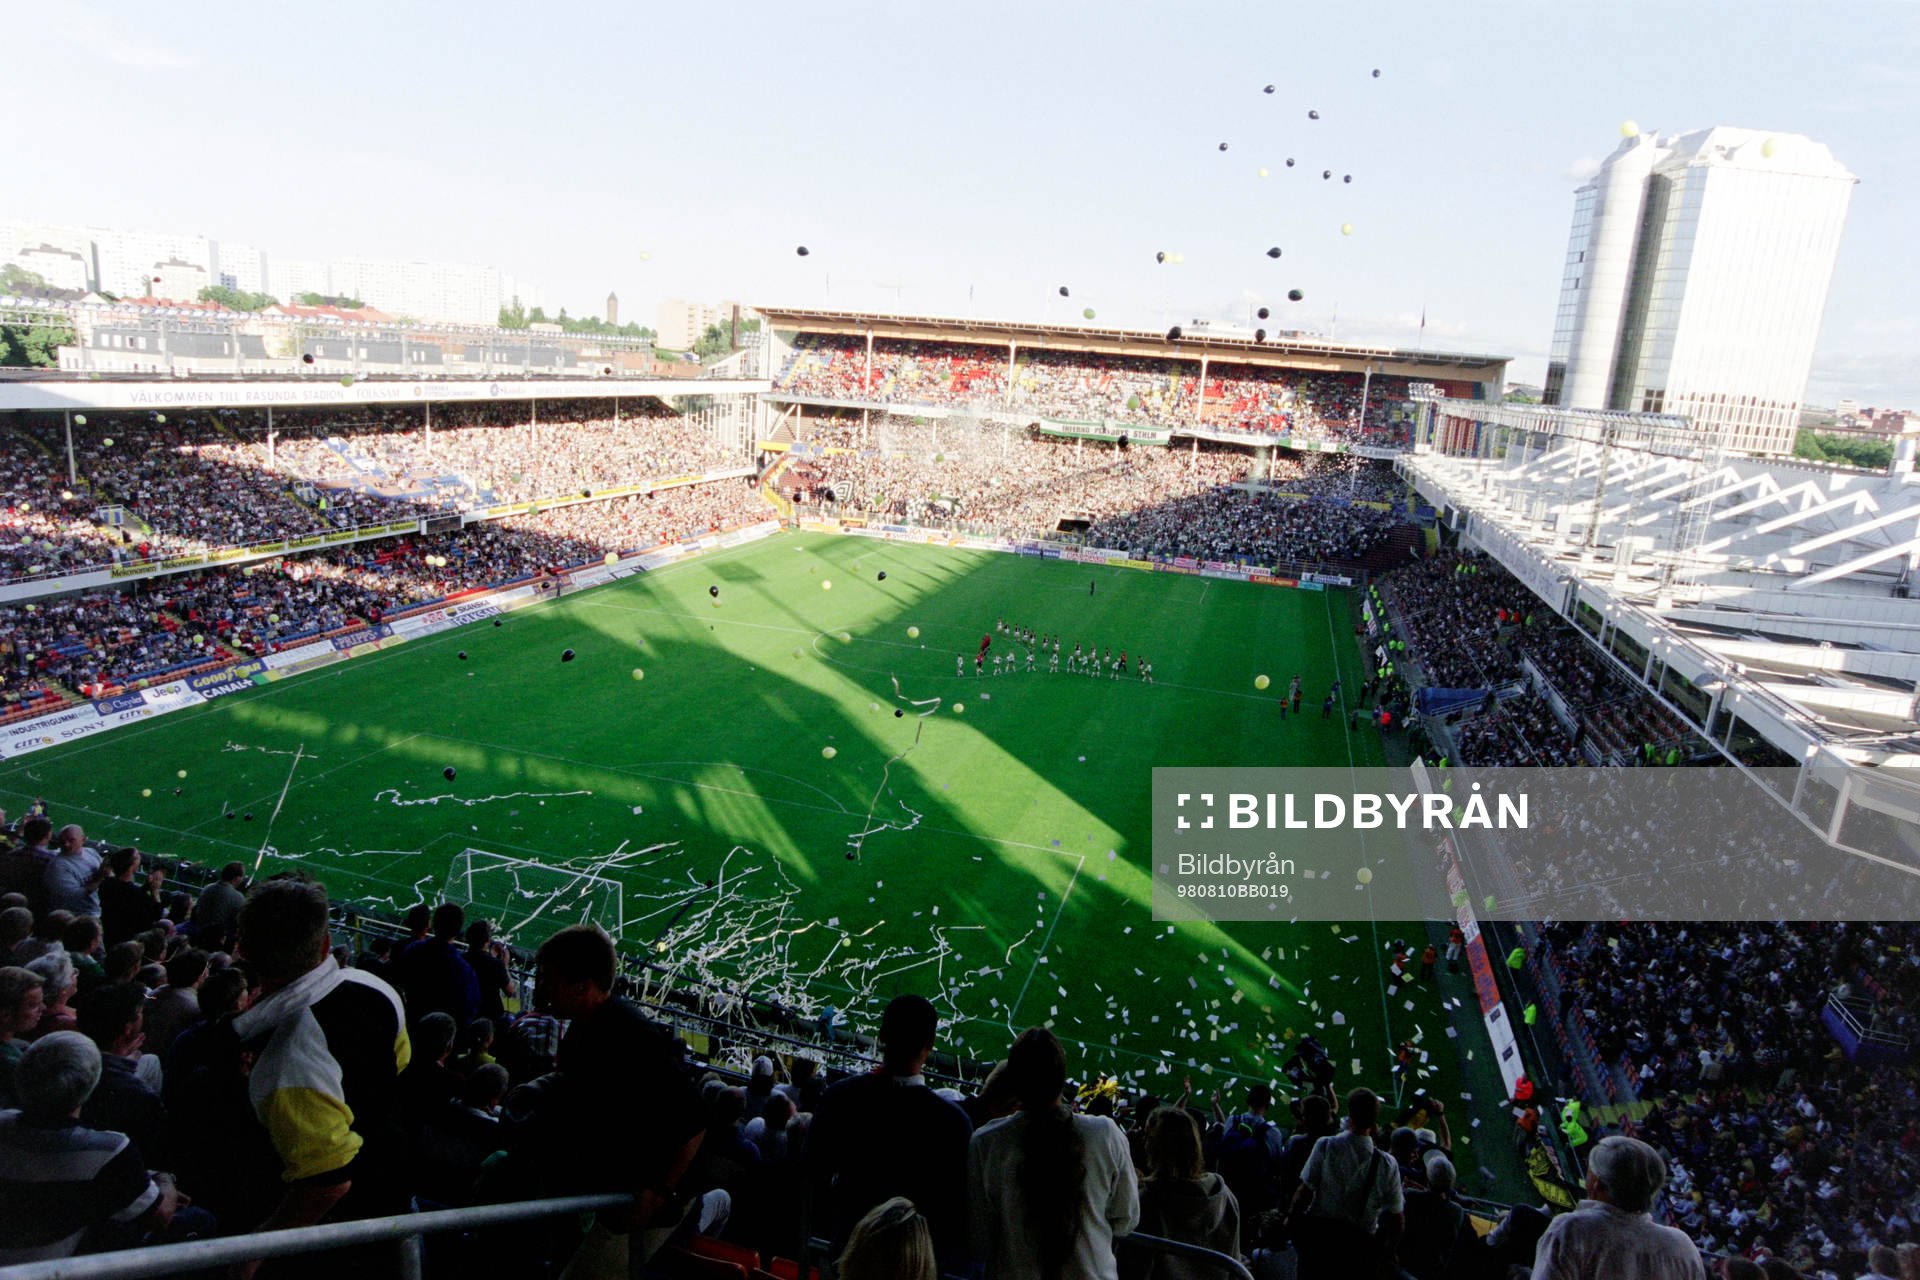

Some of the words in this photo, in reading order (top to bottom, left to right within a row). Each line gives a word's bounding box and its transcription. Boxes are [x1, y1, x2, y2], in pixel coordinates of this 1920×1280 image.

[152, 684, 182, 698] Jep
[60, 720, 106, 738] SONY
[14, 736, 42, 749] CITY
